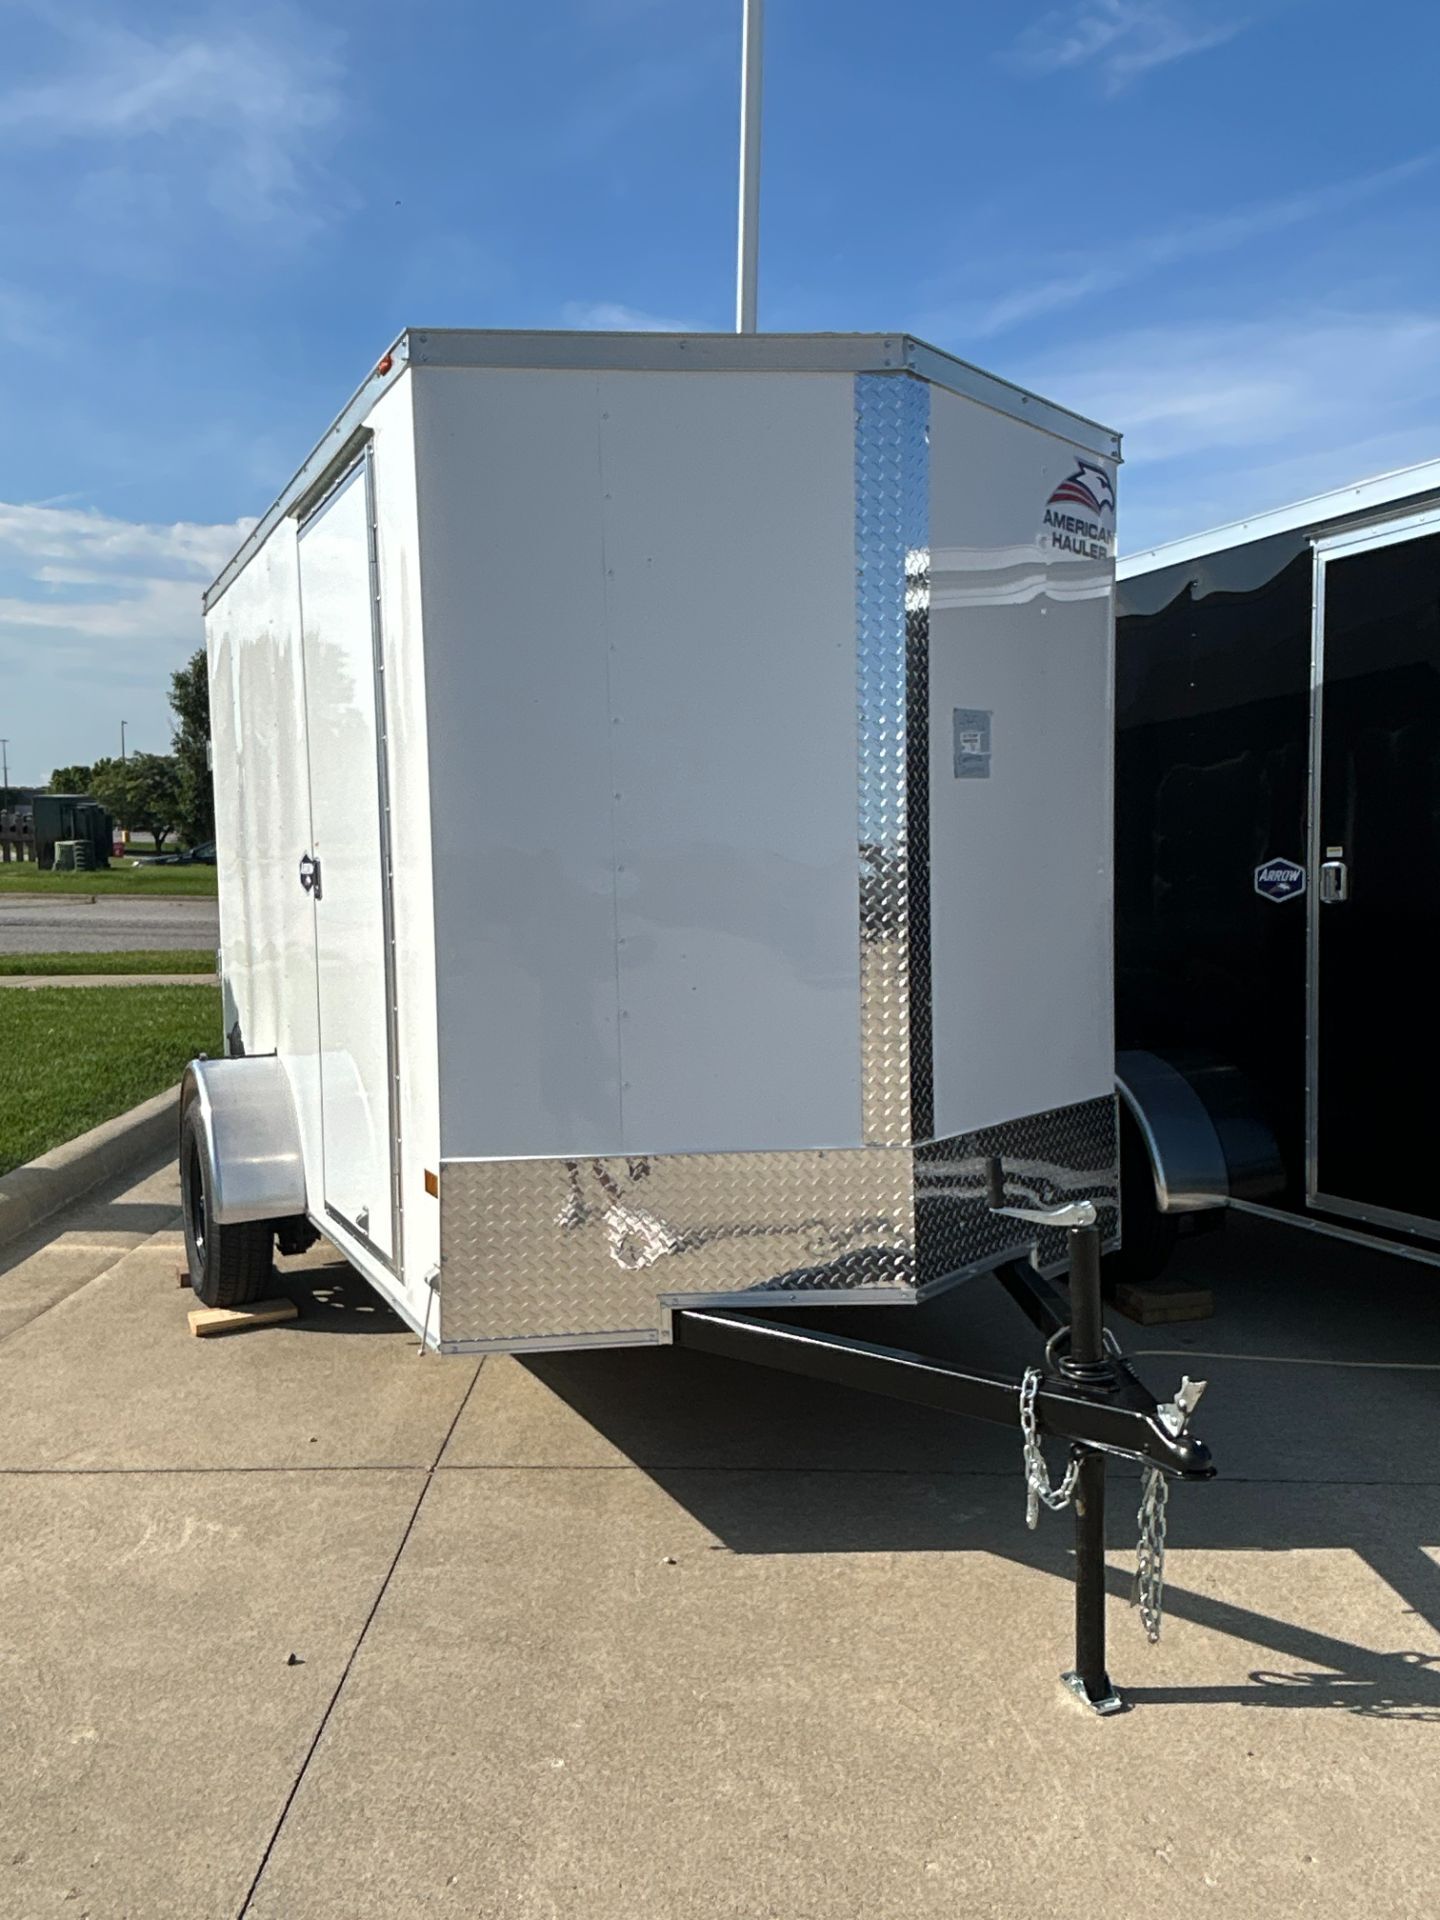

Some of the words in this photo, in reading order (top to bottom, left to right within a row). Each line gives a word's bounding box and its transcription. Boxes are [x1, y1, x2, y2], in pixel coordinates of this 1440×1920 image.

[1043, 509, 1115, 544] AMERICAN
[1052, 532, 1107, 560] HAULER
[1259, 868, 1301, 882] ARROW
